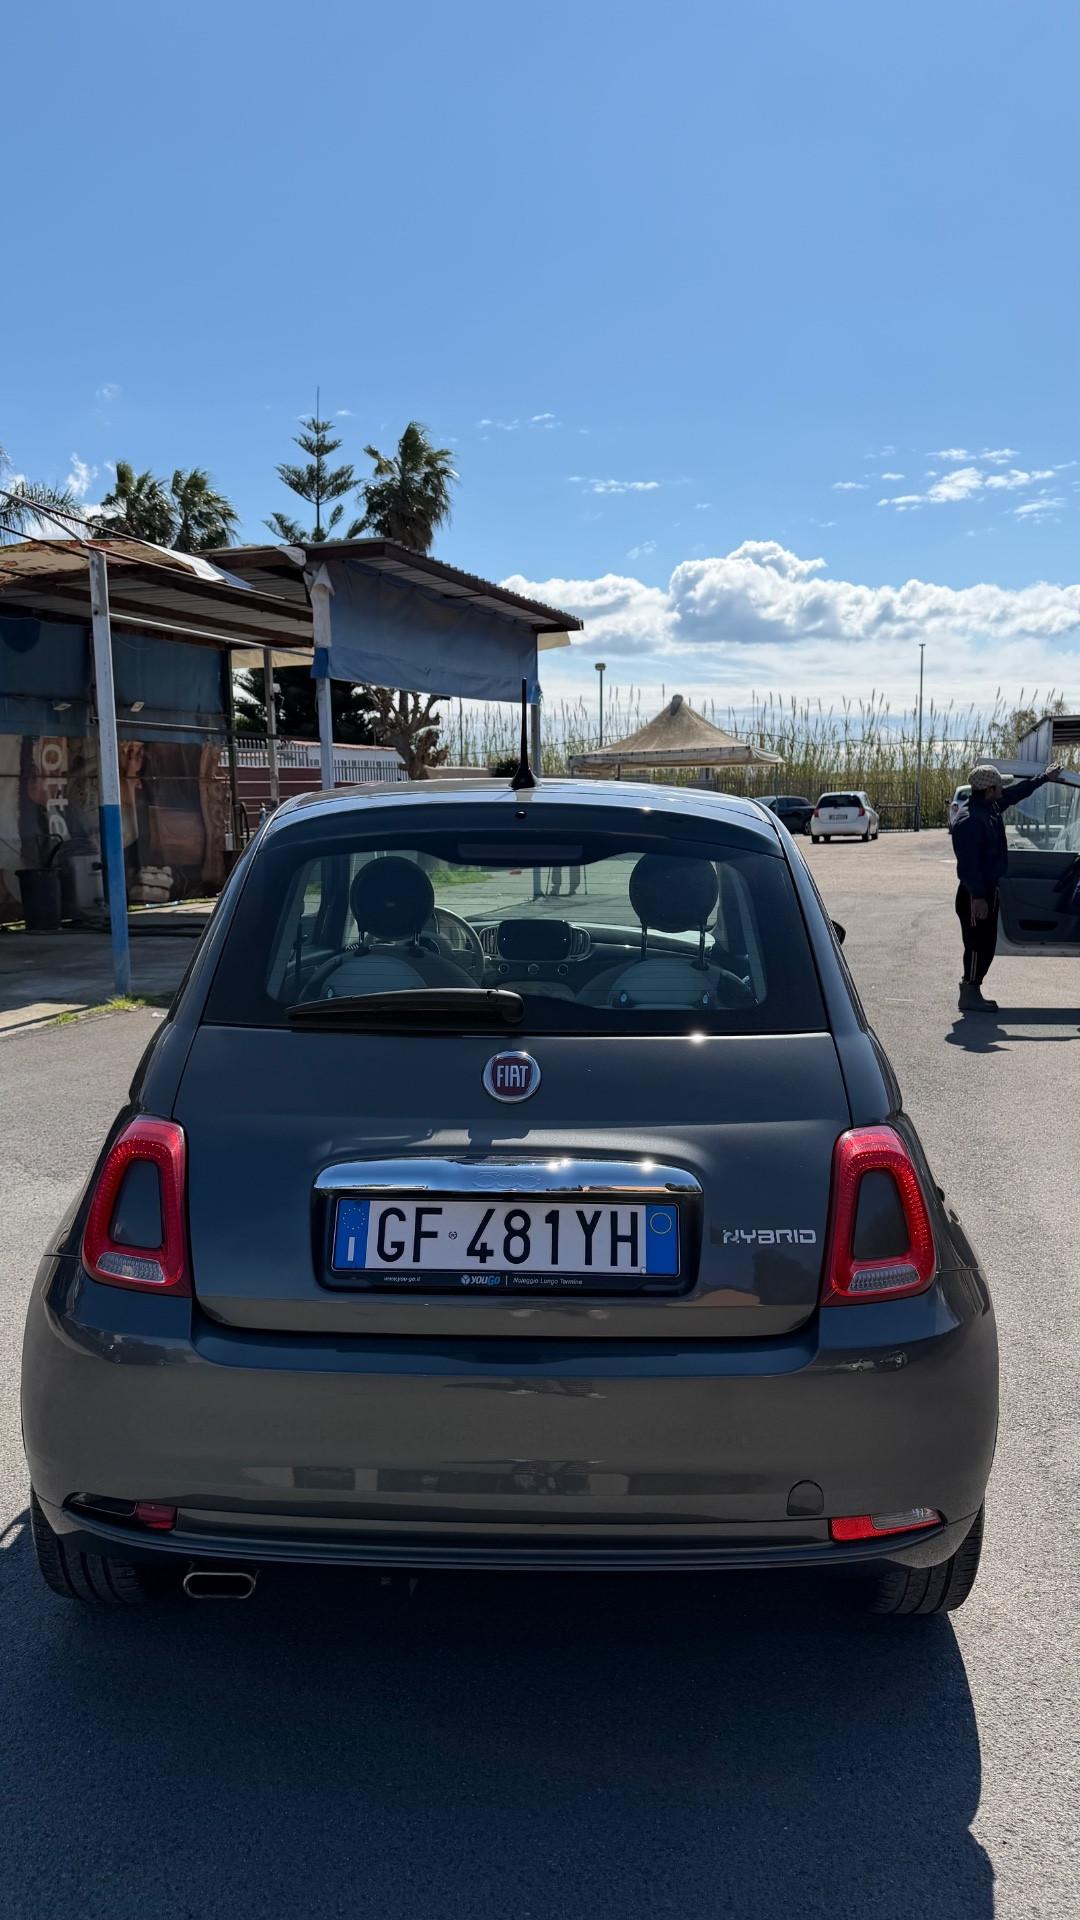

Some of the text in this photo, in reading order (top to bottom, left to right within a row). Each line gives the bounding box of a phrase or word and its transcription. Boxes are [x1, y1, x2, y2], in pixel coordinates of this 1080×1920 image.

[497, 1065, 528, 1088] FIAT
[377, 1207, 638, 1267] GF 481YH
[722, 1229, 817, 1244] HYBRID
